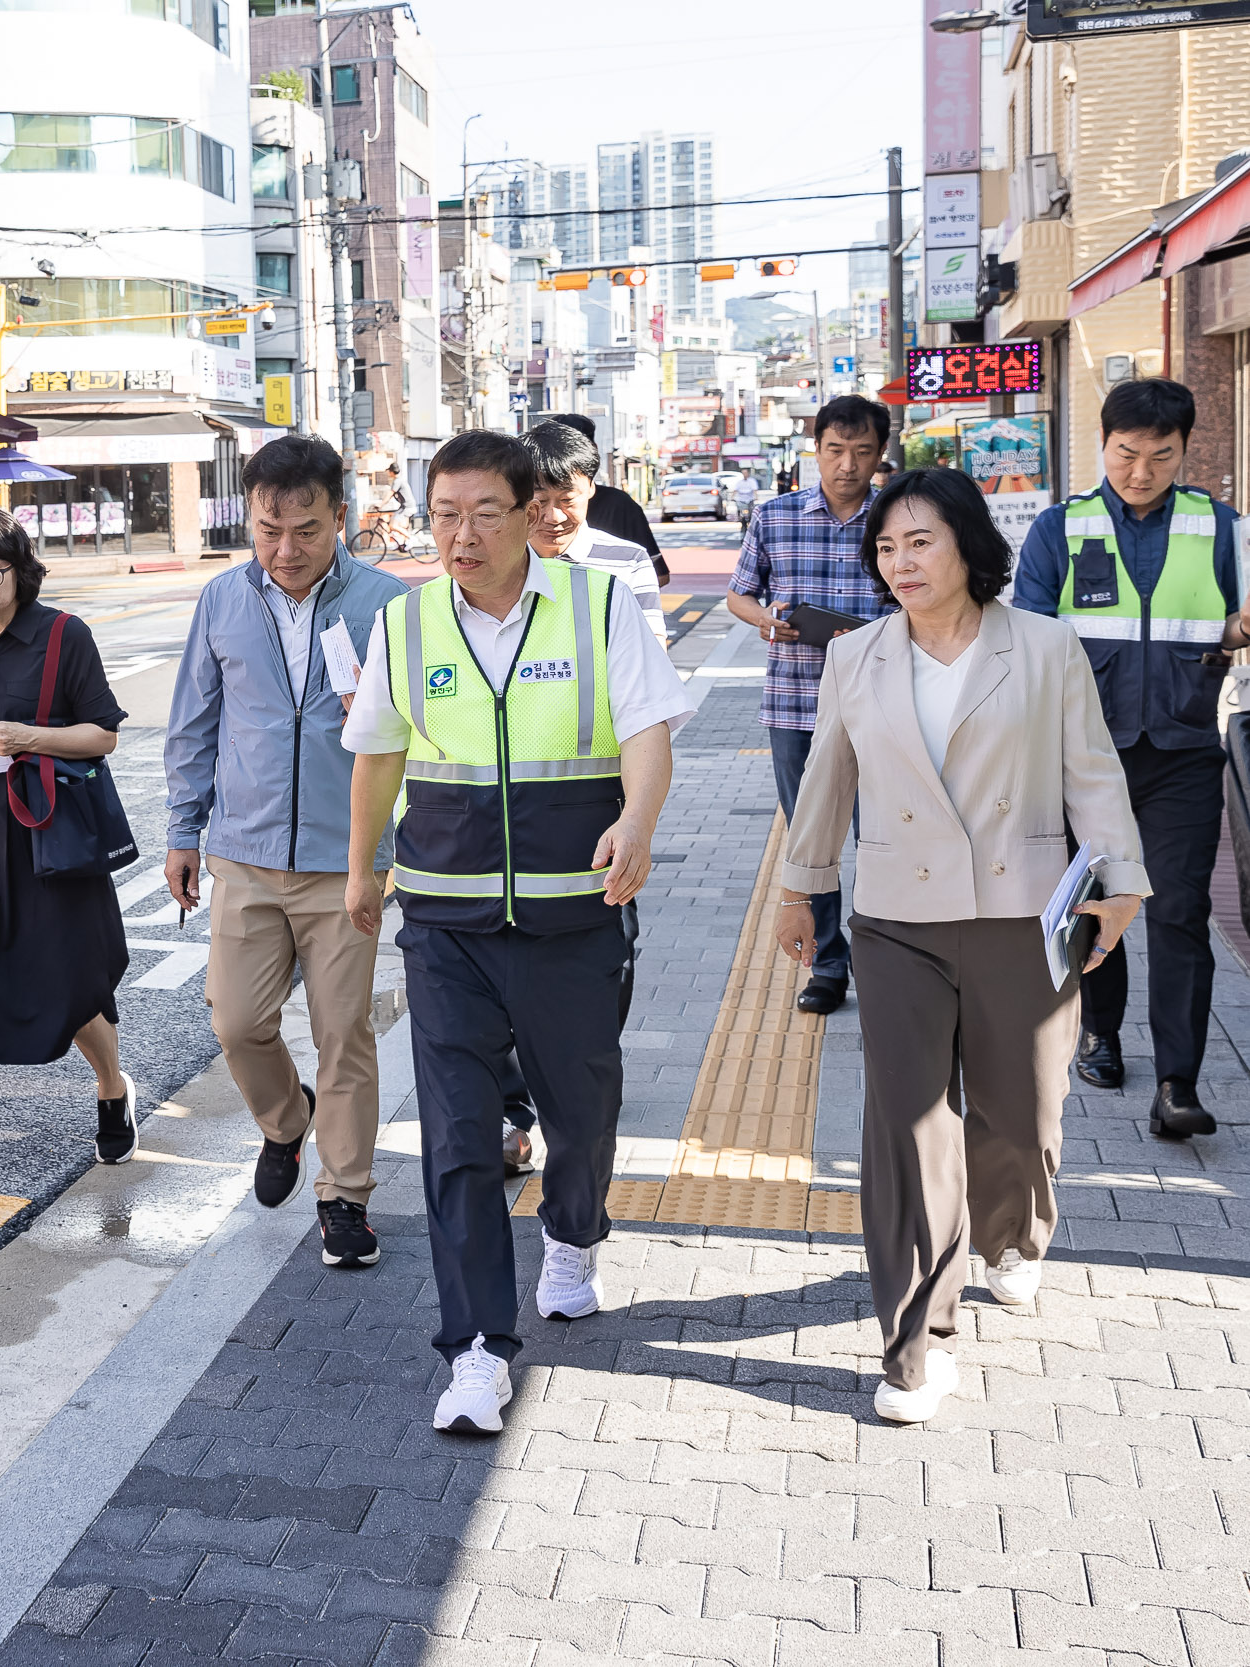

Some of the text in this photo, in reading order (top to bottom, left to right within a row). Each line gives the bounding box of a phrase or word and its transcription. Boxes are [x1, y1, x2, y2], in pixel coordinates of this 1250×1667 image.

[72, 369, 125, 392] 생고기
[127, 370, 172, 391] 전문점
[971, 448, 1040, 466] HOLIDAY
[971, 461, 1041, 478] PACKERS
